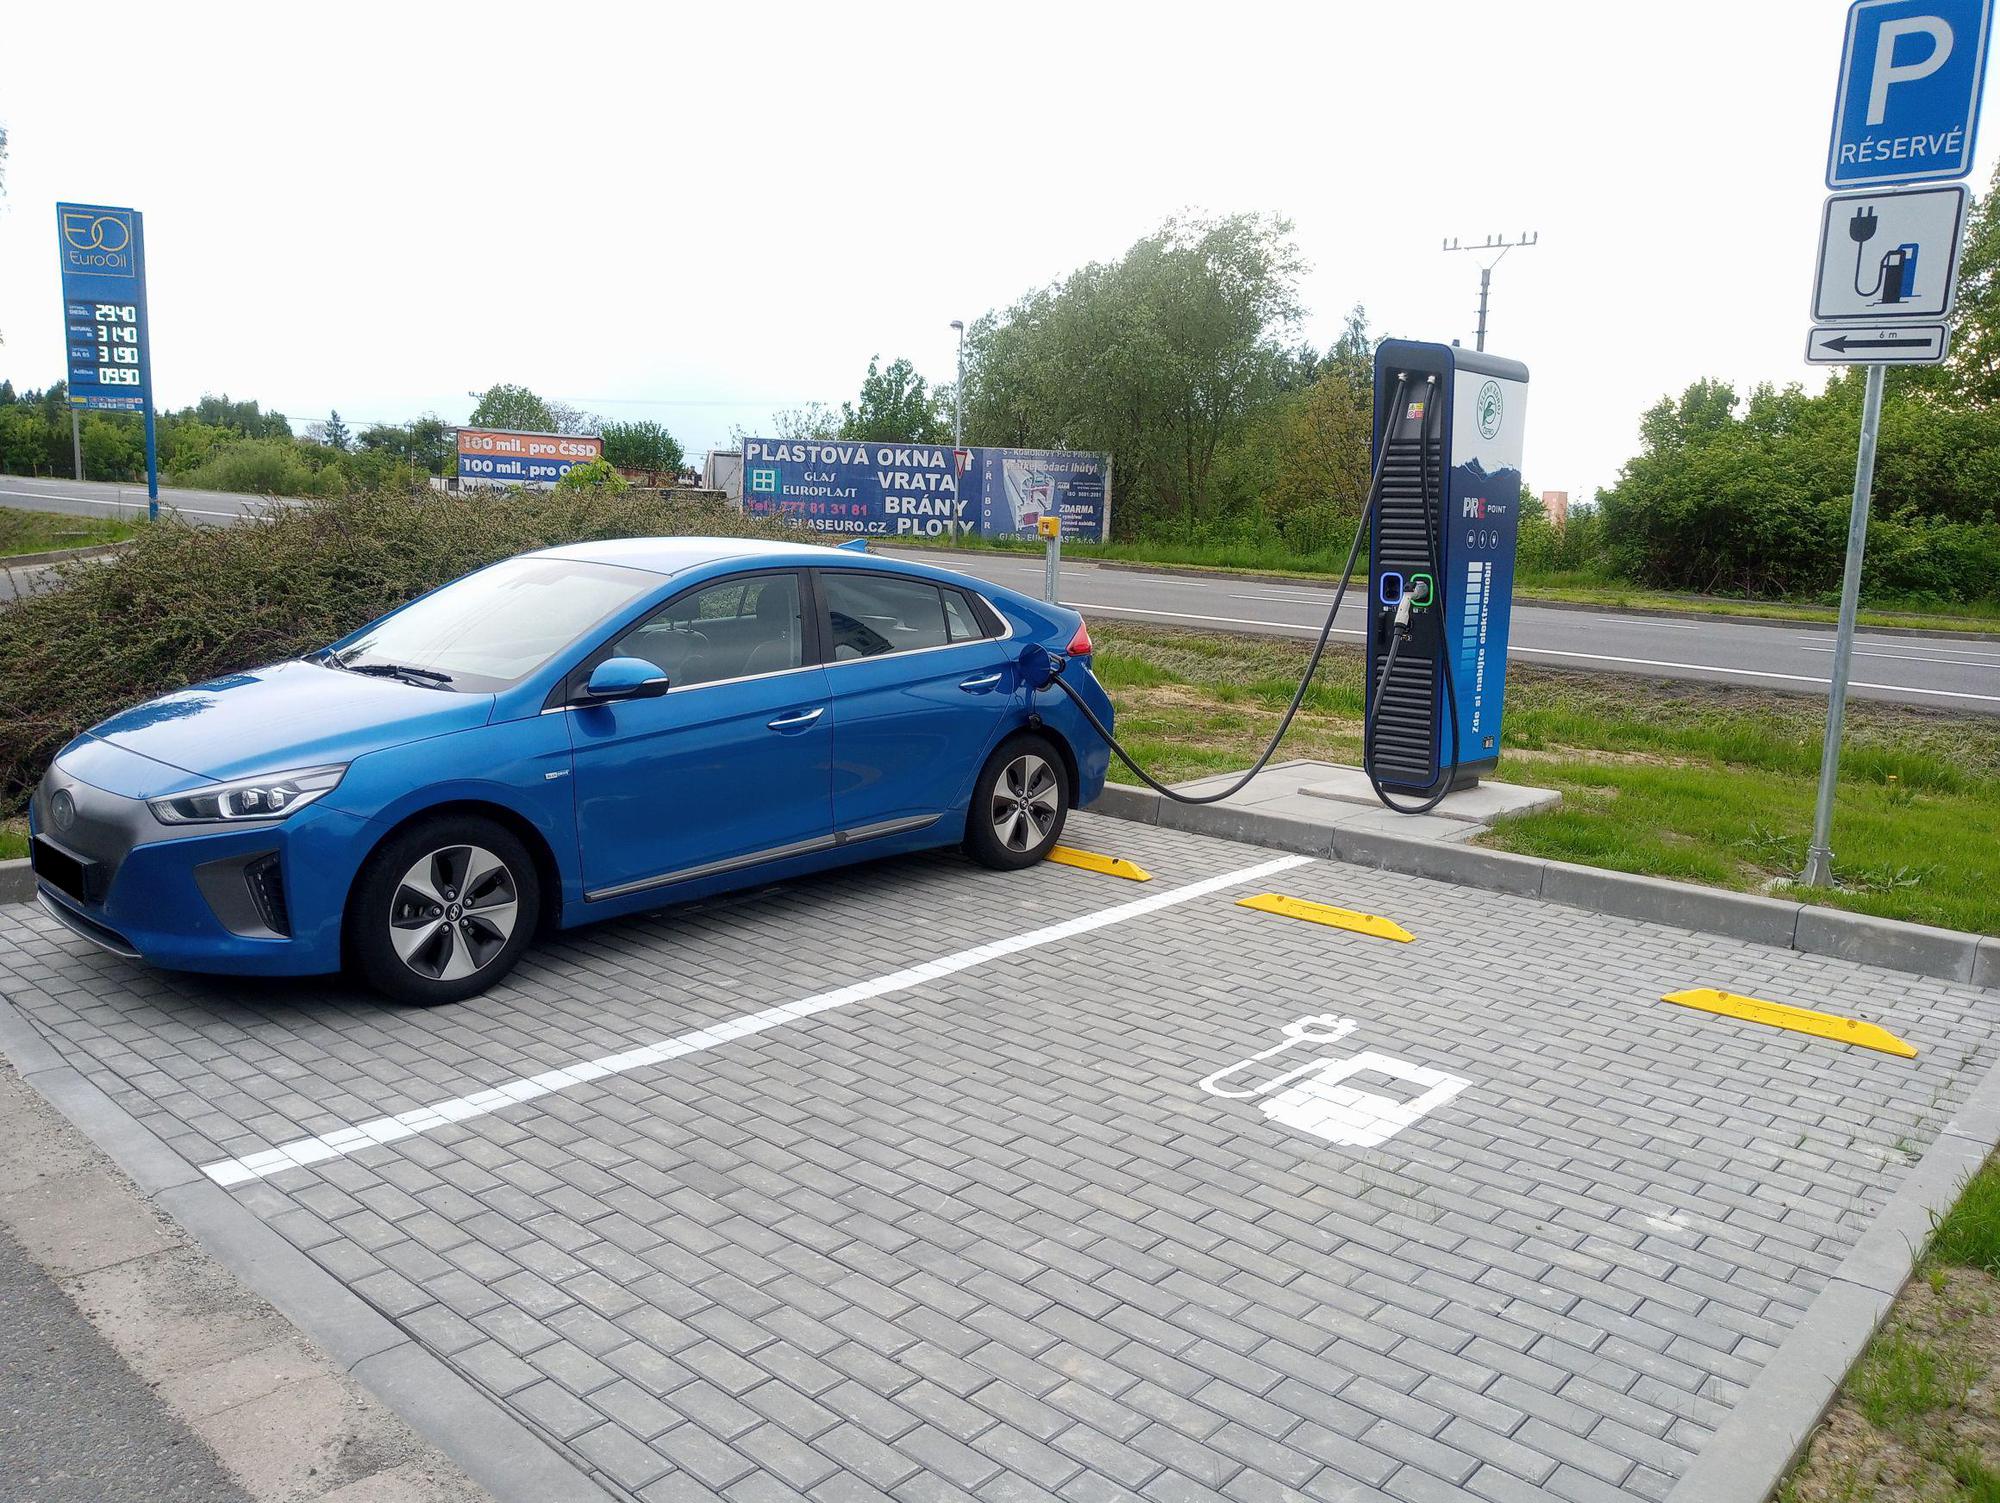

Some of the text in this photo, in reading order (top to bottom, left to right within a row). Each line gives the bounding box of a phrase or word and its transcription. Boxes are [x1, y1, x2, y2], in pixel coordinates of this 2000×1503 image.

[1865, 15, 1954, 126] P
[1840, 125, 1962, 165] RÉSERVÉ
[69, 251, 127, 268] EuroOil
[1879, 331, 1885, 339] 6
[463, 436, 597, 457] 100 mil. pro ČSSD
[746, 443, 946, 468] PLASTOVÁ OKNA
[463, 458, 493, 473] 100
[496, 461, 526, 475] mil.
[529, 465, 556, 478] pro
[803, 471, 837, 482] GLAS
[782, 485, 858, 498] EUROPLAST
[877, 471, 957, 492] VRATA
[884, 493, 969, 517] BRÁNY
[1059, 504, 1094, 514] ZDARMA
[1462, 497, 1507, 519] PRE POINT
[897, 517, 975, 537] PLOTY
[1480, 561, 1492, 645] elektromobil
[1474, 695, 1482, 709] si
[1471, 714, 1481, 734] Zde
